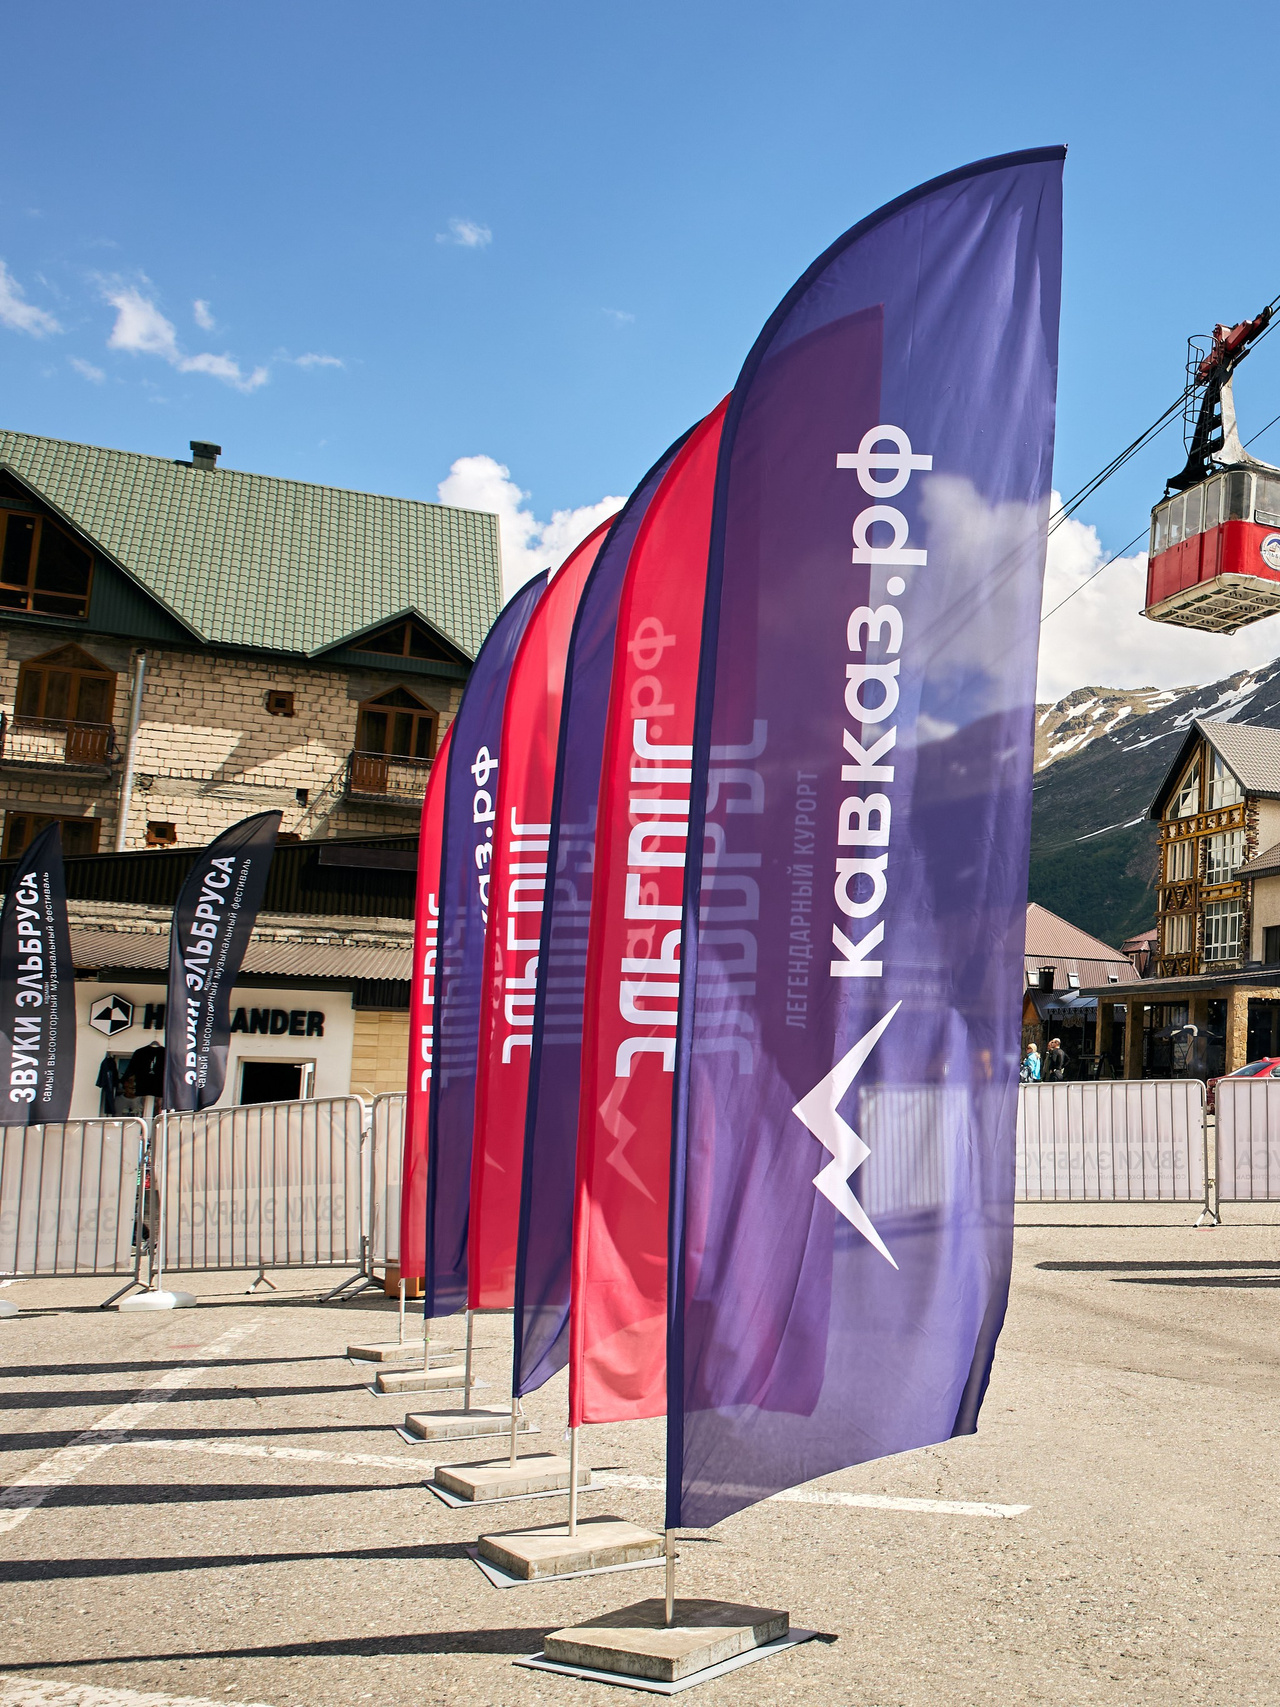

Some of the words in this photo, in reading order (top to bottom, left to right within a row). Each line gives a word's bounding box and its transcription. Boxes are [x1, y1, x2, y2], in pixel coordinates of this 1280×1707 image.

[830, 423, 933, 978] кавказ.рф
[43, 872, 54, 922] фестиваль
[184, 856, 236, 992] ЭЛЬБРУСА
[215, 913, 237, 980] музыкальный
[232, 858, 251, 910] фестиваль
[15, 872, 43, 1008] ЭЛЬБРУСА
[46, 926, 59, 990] музыкальный
[9, 1016, 42, 1103] ЗВУКИ
[48, 993, 59, 1066] высокогорный
[143, 1003, 325, 1036] HANDER
[43, 1070, 55, 1102] самый
